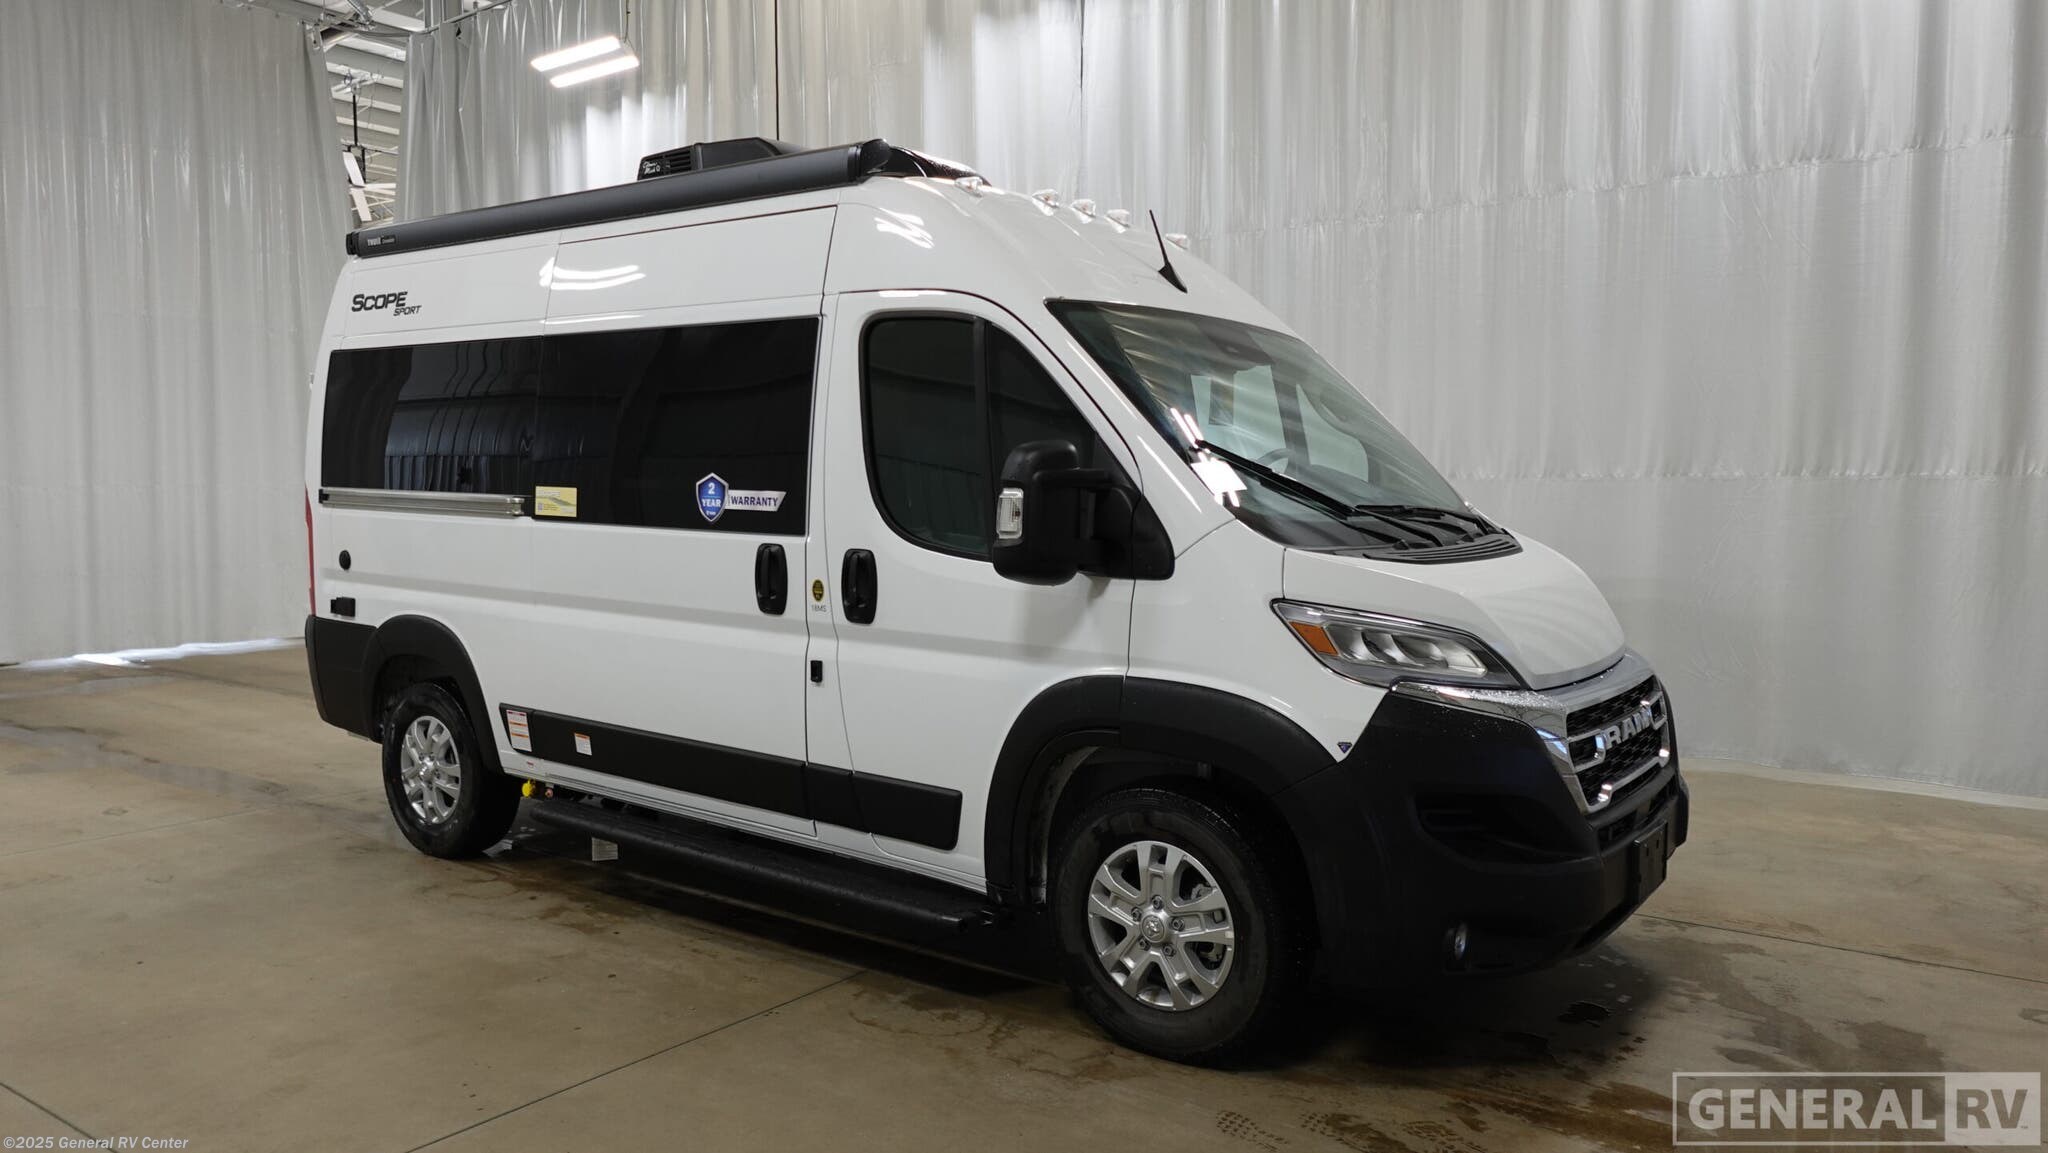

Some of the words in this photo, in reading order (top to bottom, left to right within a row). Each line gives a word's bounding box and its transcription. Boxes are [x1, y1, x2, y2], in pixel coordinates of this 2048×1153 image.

[351, 291, 408, 312] SCOPE
[393, 305, 422, 317] SPORT
[707, 482, 716, 495] 2
[702, 498, 722, 508] YEAR
[730, 495, 779, 507] WARRANTY
[1601, 705, 1652, 750] RAM
